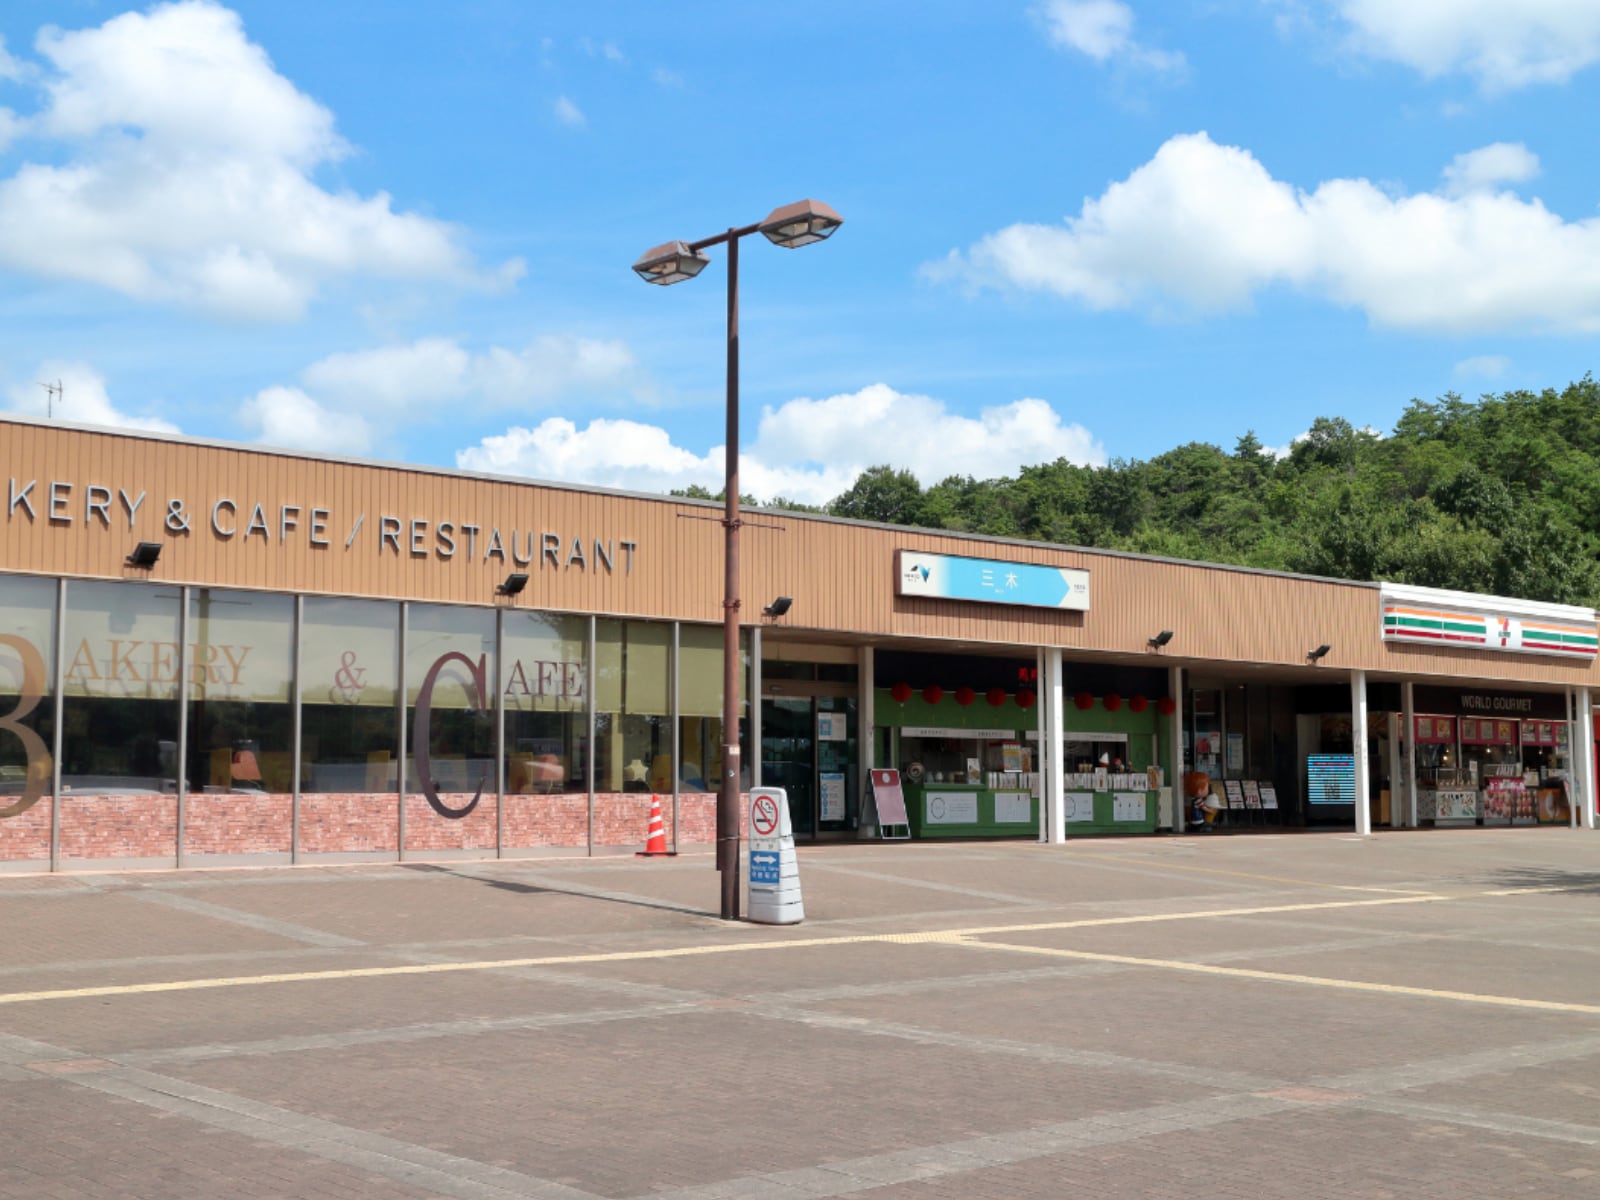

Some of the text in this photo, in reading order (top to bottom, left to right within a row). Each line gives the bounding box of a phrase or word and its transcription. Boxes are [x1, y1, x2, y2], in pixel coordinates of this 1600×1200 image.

[9, 478, 146, 527] KERY
[166, 499, 191, 531] &
[212, 499, 331, 545] CAFE
[379, 516, 637, 574] RESTAURANT
[981, 569, 1019, 589] 三木
[334, 650, 367, 690] &
[1461, 696, 1532, 712] WORLD GOURMET
